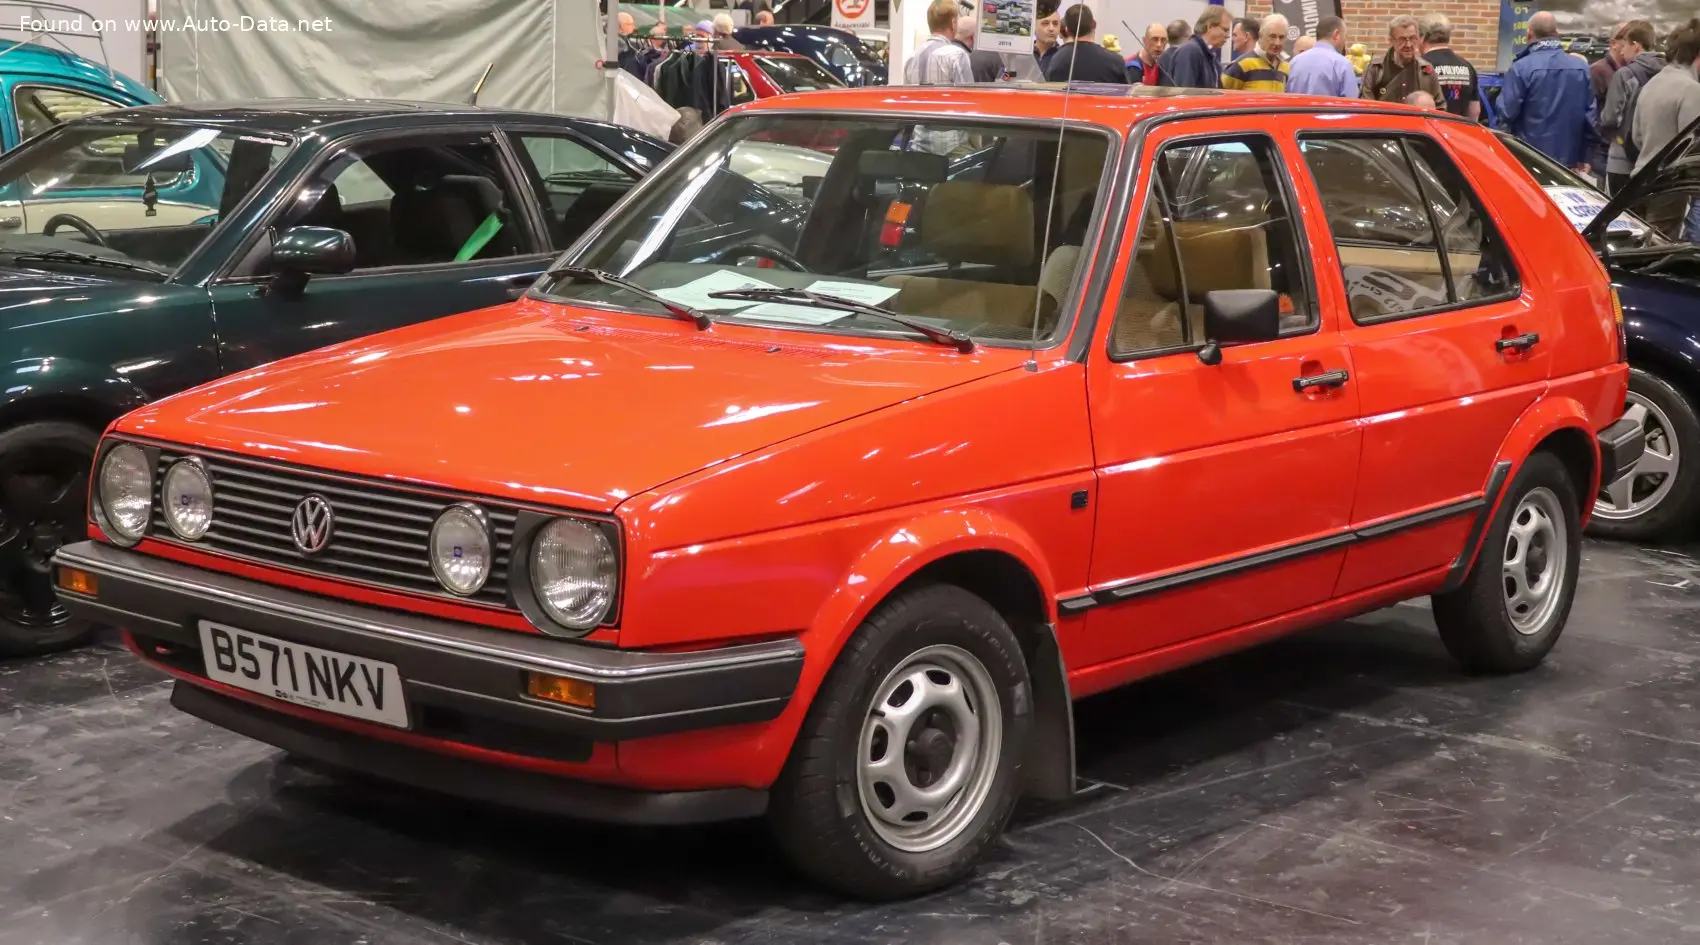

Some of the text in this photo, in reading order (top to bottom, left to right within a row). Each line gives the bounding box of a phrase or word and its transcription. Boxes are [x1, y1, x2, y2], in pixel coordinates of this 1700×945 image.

[293, 497, 330, 551] VW
[210, 628, 384, 711] B571 NKV
